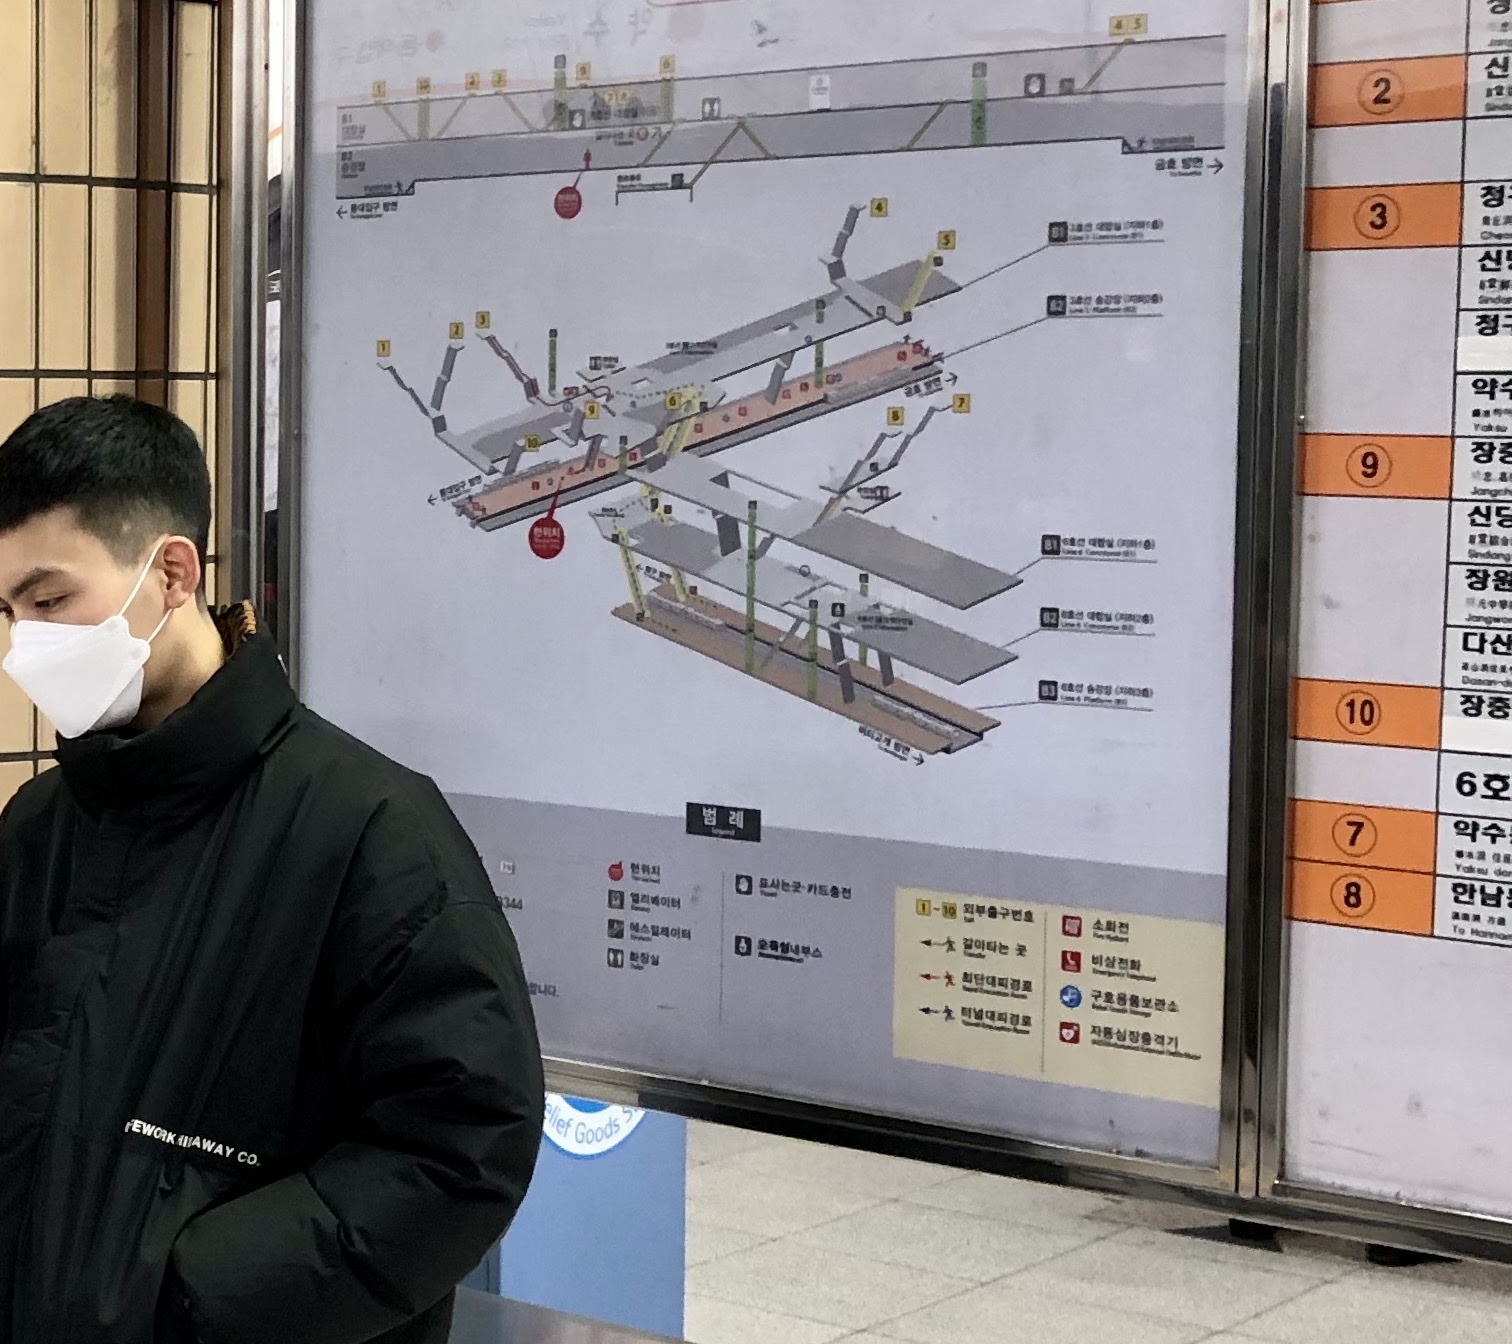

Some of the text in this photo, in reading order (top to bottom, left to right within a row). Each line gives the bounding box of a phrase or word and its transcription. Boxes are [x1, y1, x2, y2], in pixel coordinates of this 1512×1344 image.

[1345, 698, 1376, 727] 10
[1453, 819, 1512, 844] 약수
[1450, 882, 1512, 909] 한남
[574, 1117, 621, 1145] Goods
